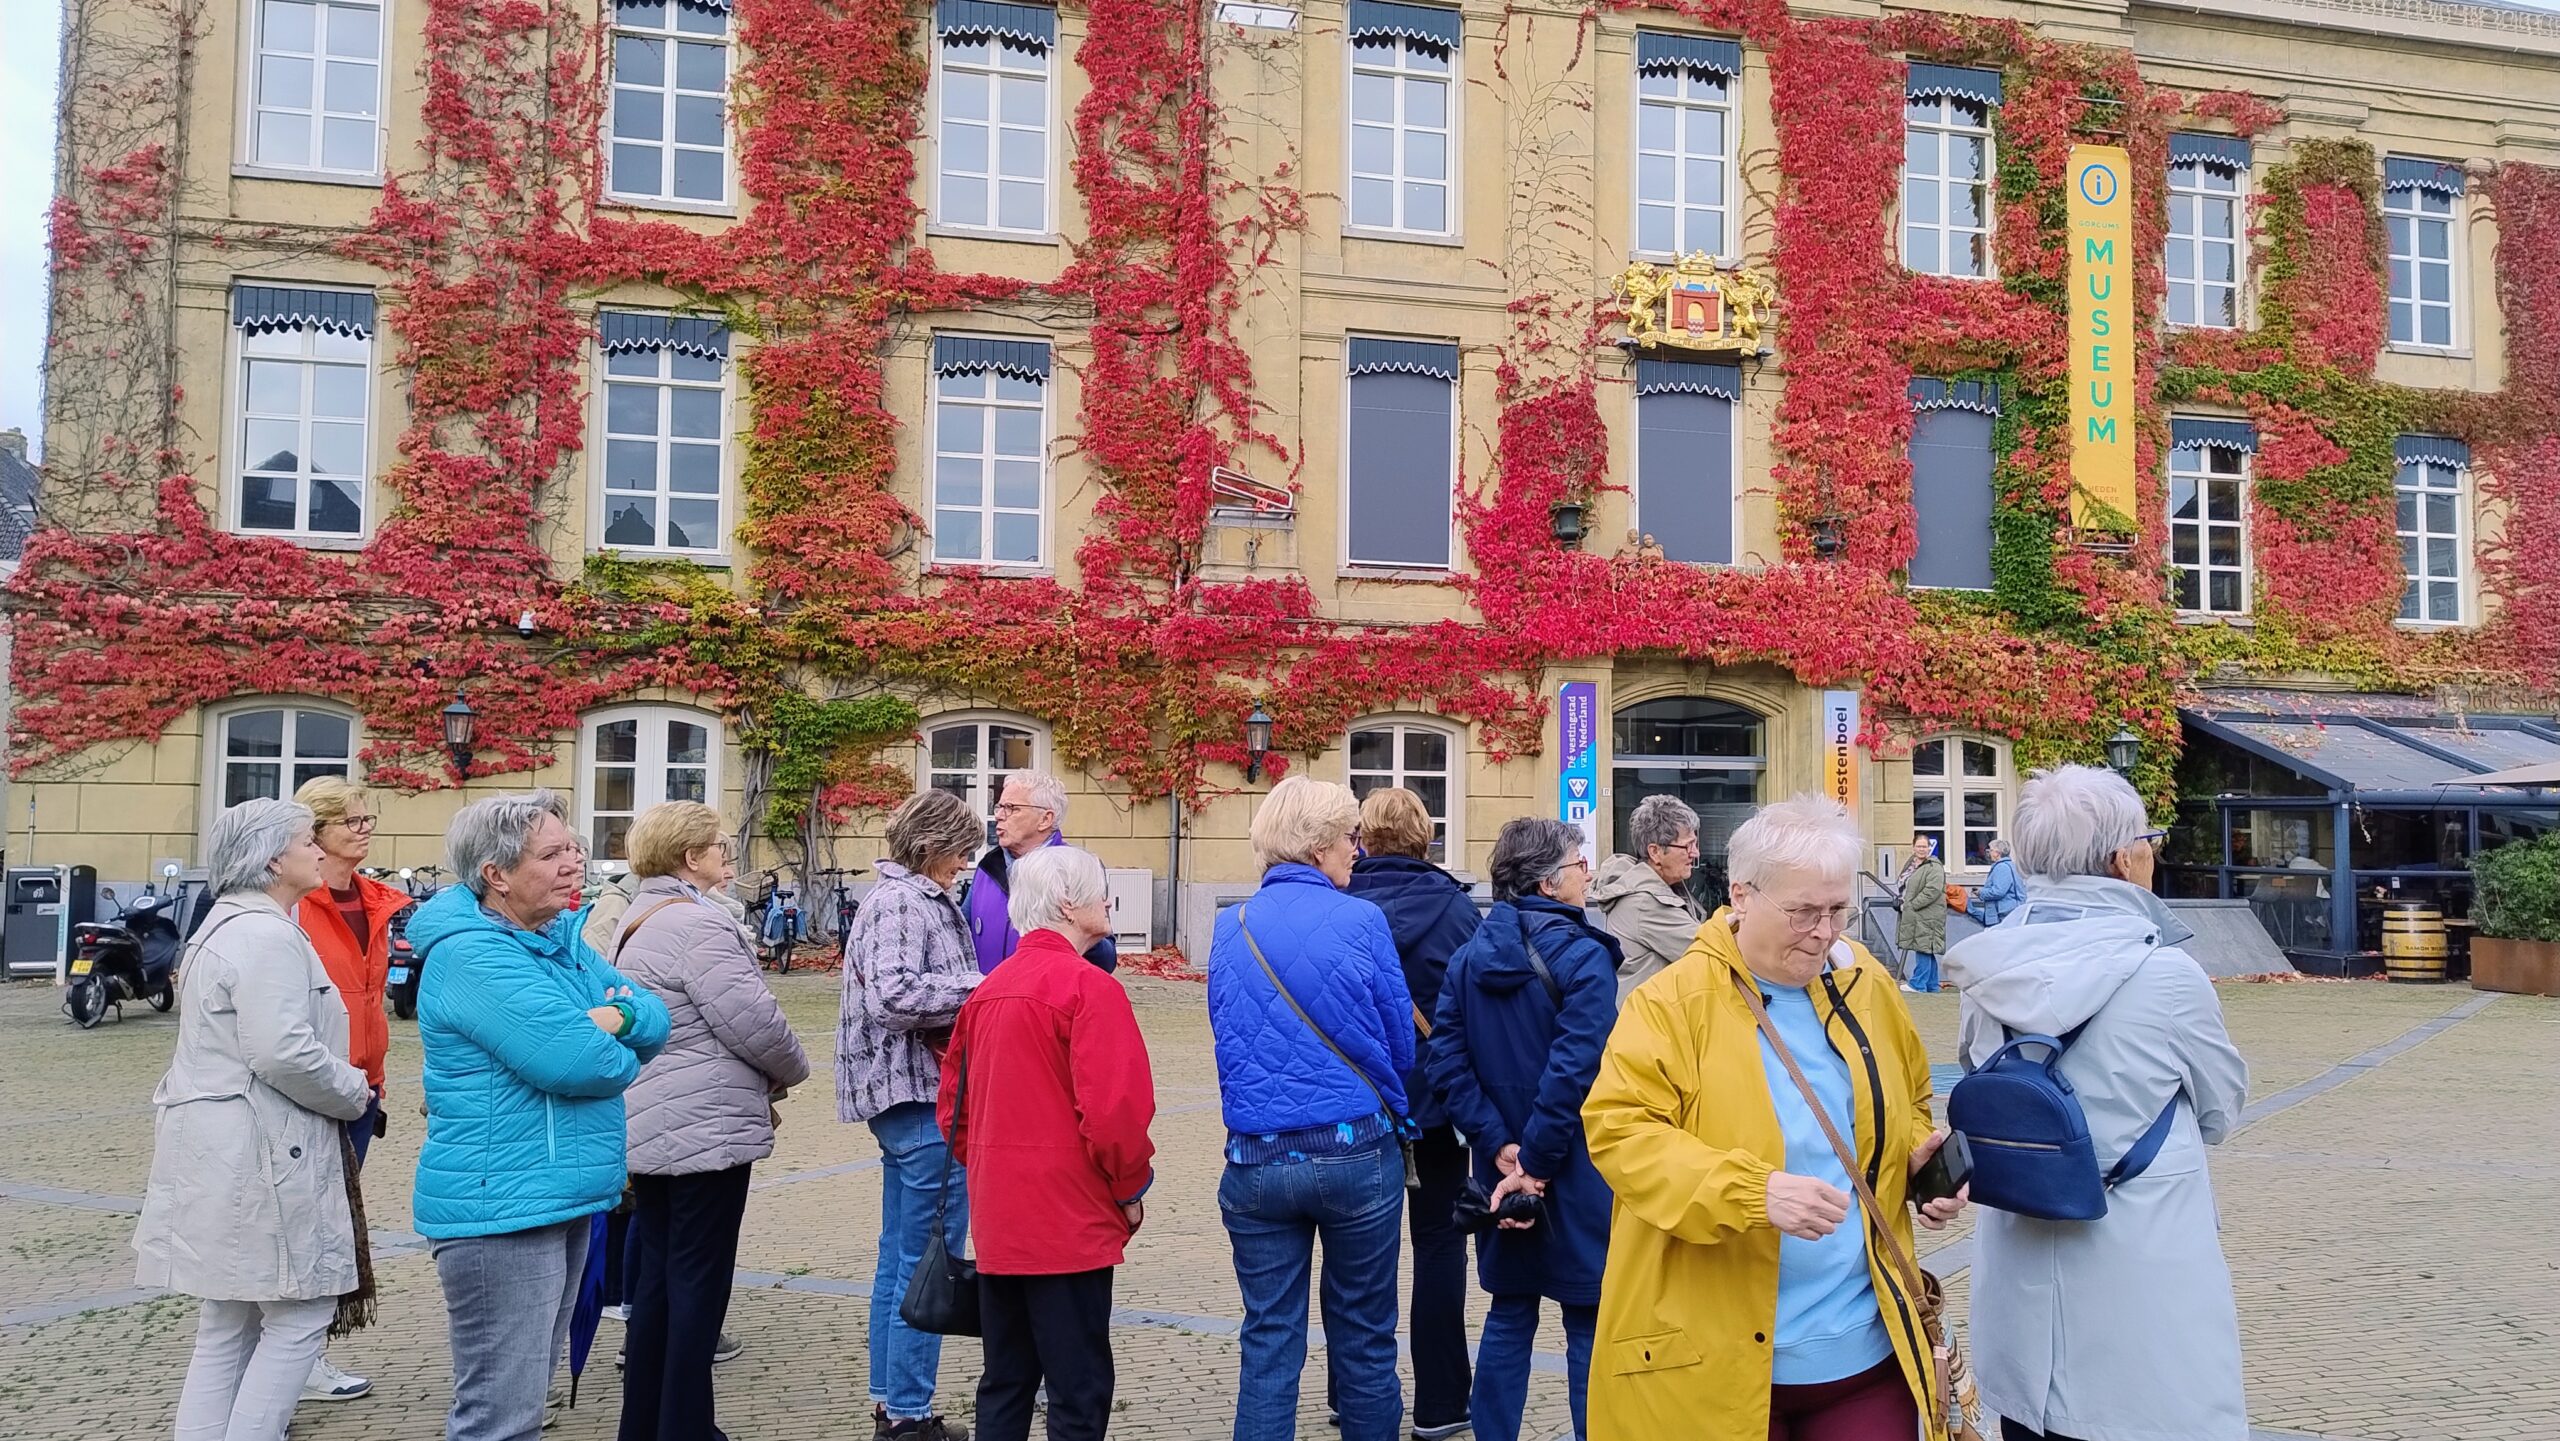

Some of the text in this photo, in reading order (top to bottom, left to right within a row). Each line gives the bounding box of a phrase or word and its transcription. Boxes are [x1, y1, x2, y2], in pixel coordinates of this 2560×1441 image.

[2085, 238, 2116, 444] MUSEUM
[1567, 696, 1578, 769] Dé vestingstad
[1579, 696, 1588, 769] van Nederland
[1834, 707, 1848, 816] eestenboel
[1570, 780, 1587, 796] VVV
